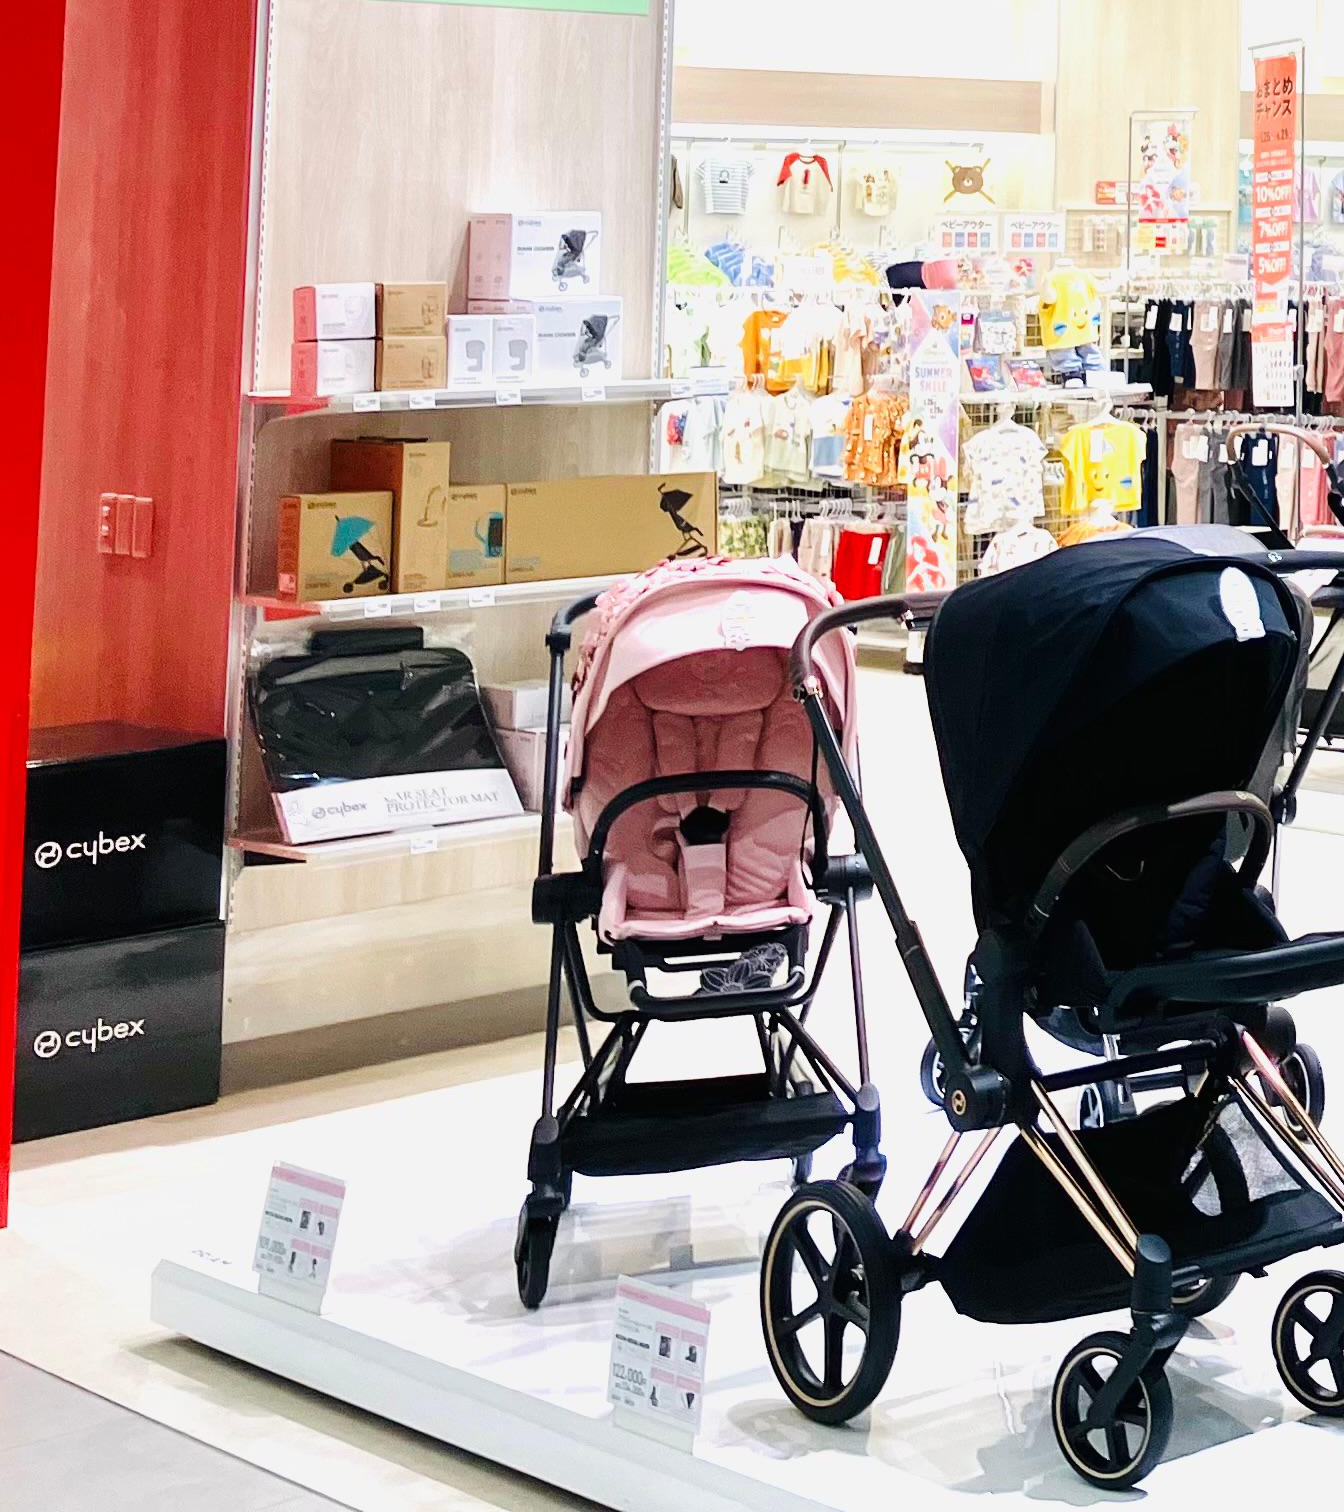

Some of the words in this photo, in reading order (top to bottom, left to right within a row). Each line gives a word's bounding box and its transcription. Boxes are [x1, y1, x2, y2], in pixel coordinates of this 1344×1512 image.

[471, 789, 500, 804] MAT
[325, 801, 368, 818] cybex
[66, 831, 147, 865] cybex
[65, 1018, 145, 1052] cybex
